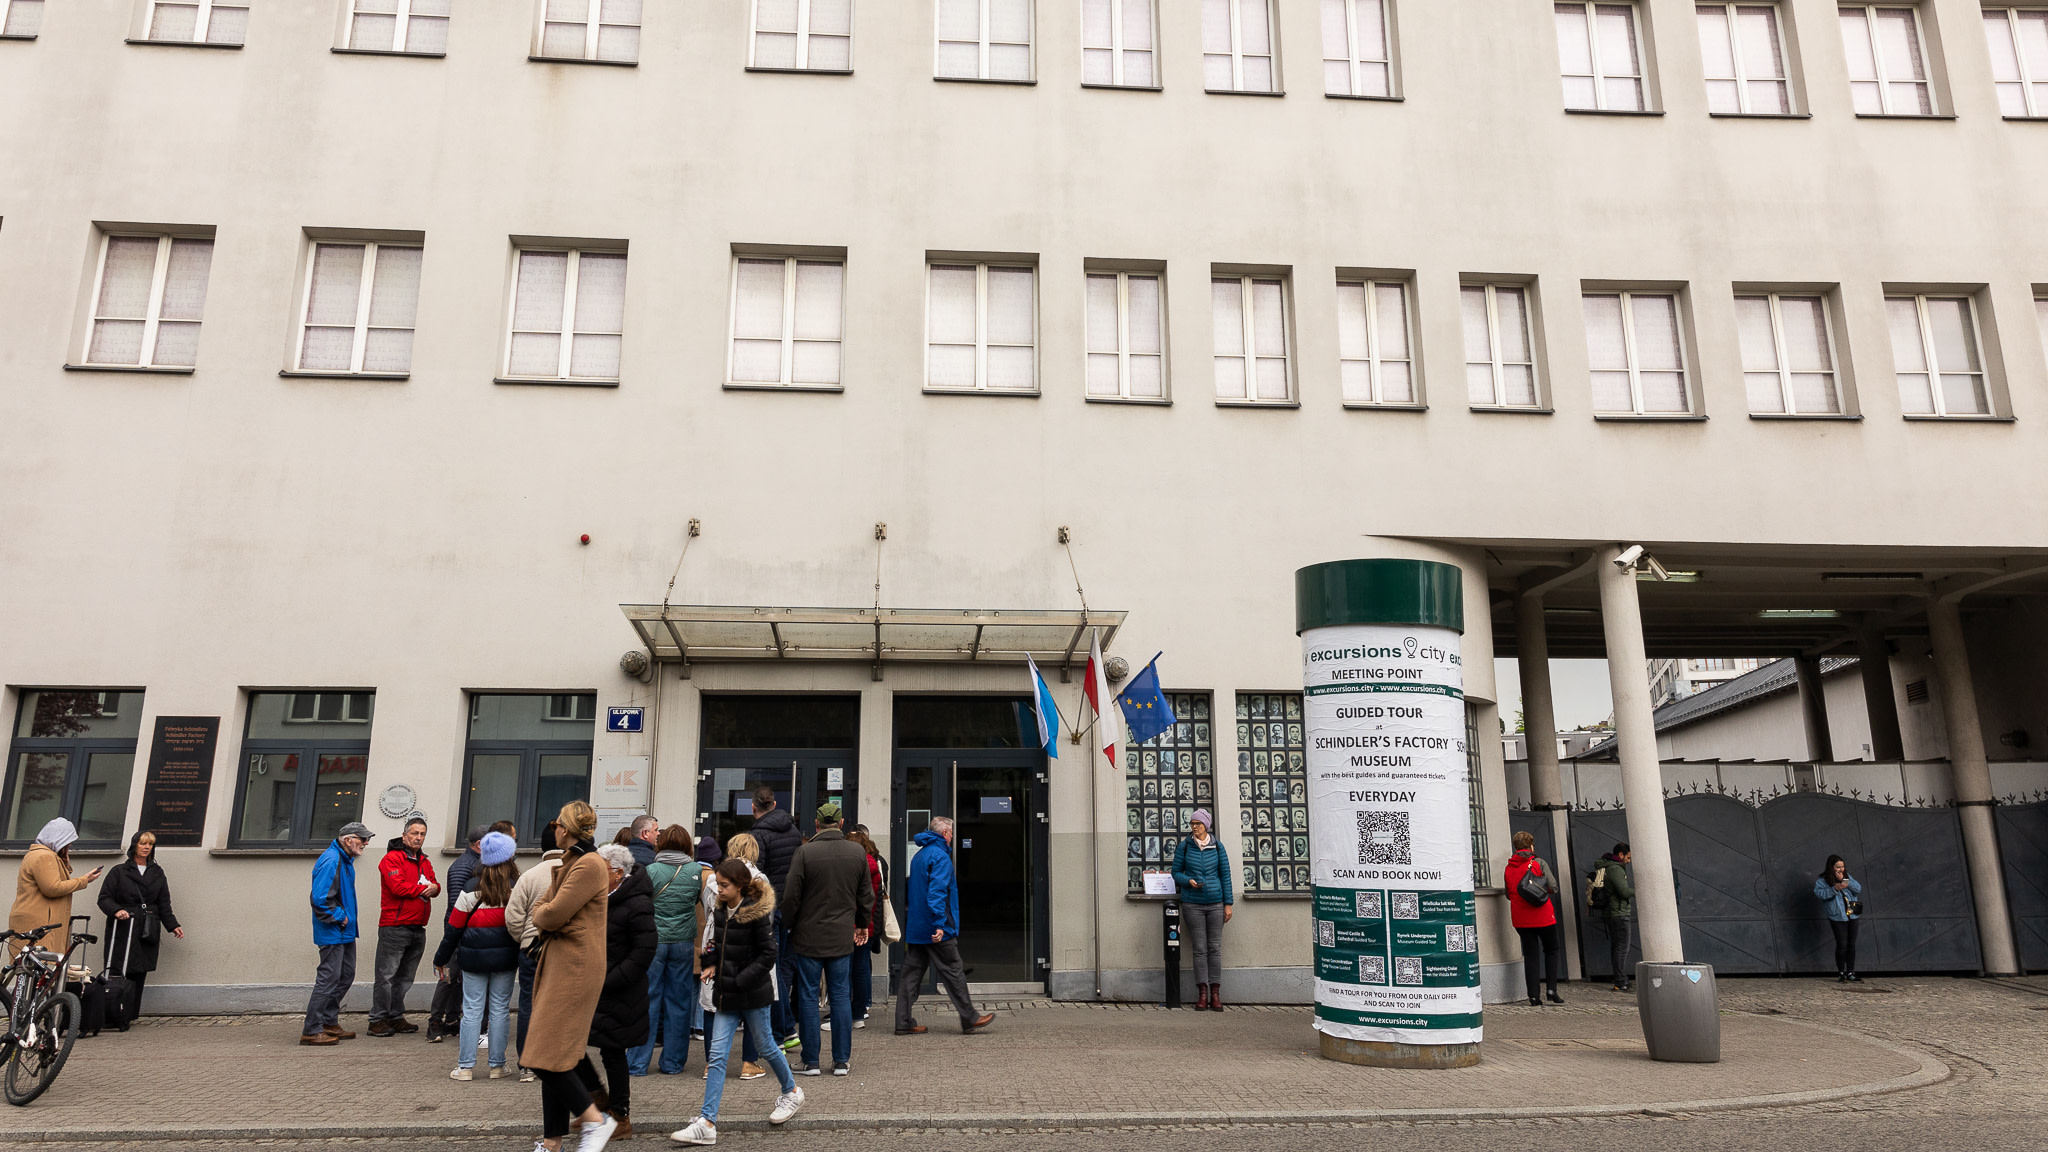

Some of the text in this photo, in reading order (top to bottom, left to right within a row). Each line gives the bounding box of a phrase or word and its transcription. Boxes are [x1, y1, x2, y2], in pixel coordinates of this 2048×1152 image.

[1310, 644, 1446, 662] excursions city
[1332, 668, 1423, 680] MEETING POINT
[1313, 685, 1374, 694] www.excursions.city
[1380, 684, 1446, 695] www.excursions.city
[1336, 707, 1423, 718] GUIDED TOUR
[618, 715, 629, 729] 4
[1315, 736, 1448, 749] SCHINDLER'S FACTORY
[1351, 756, 1411, 766] MUSEUM
[1350, 791, 1416, 802] EVERYDAY
[1333, 869, 1441, 880] SCAN AND BOOK NOW!
[1358, 1016, 1428, 1026] www.excursions.city
